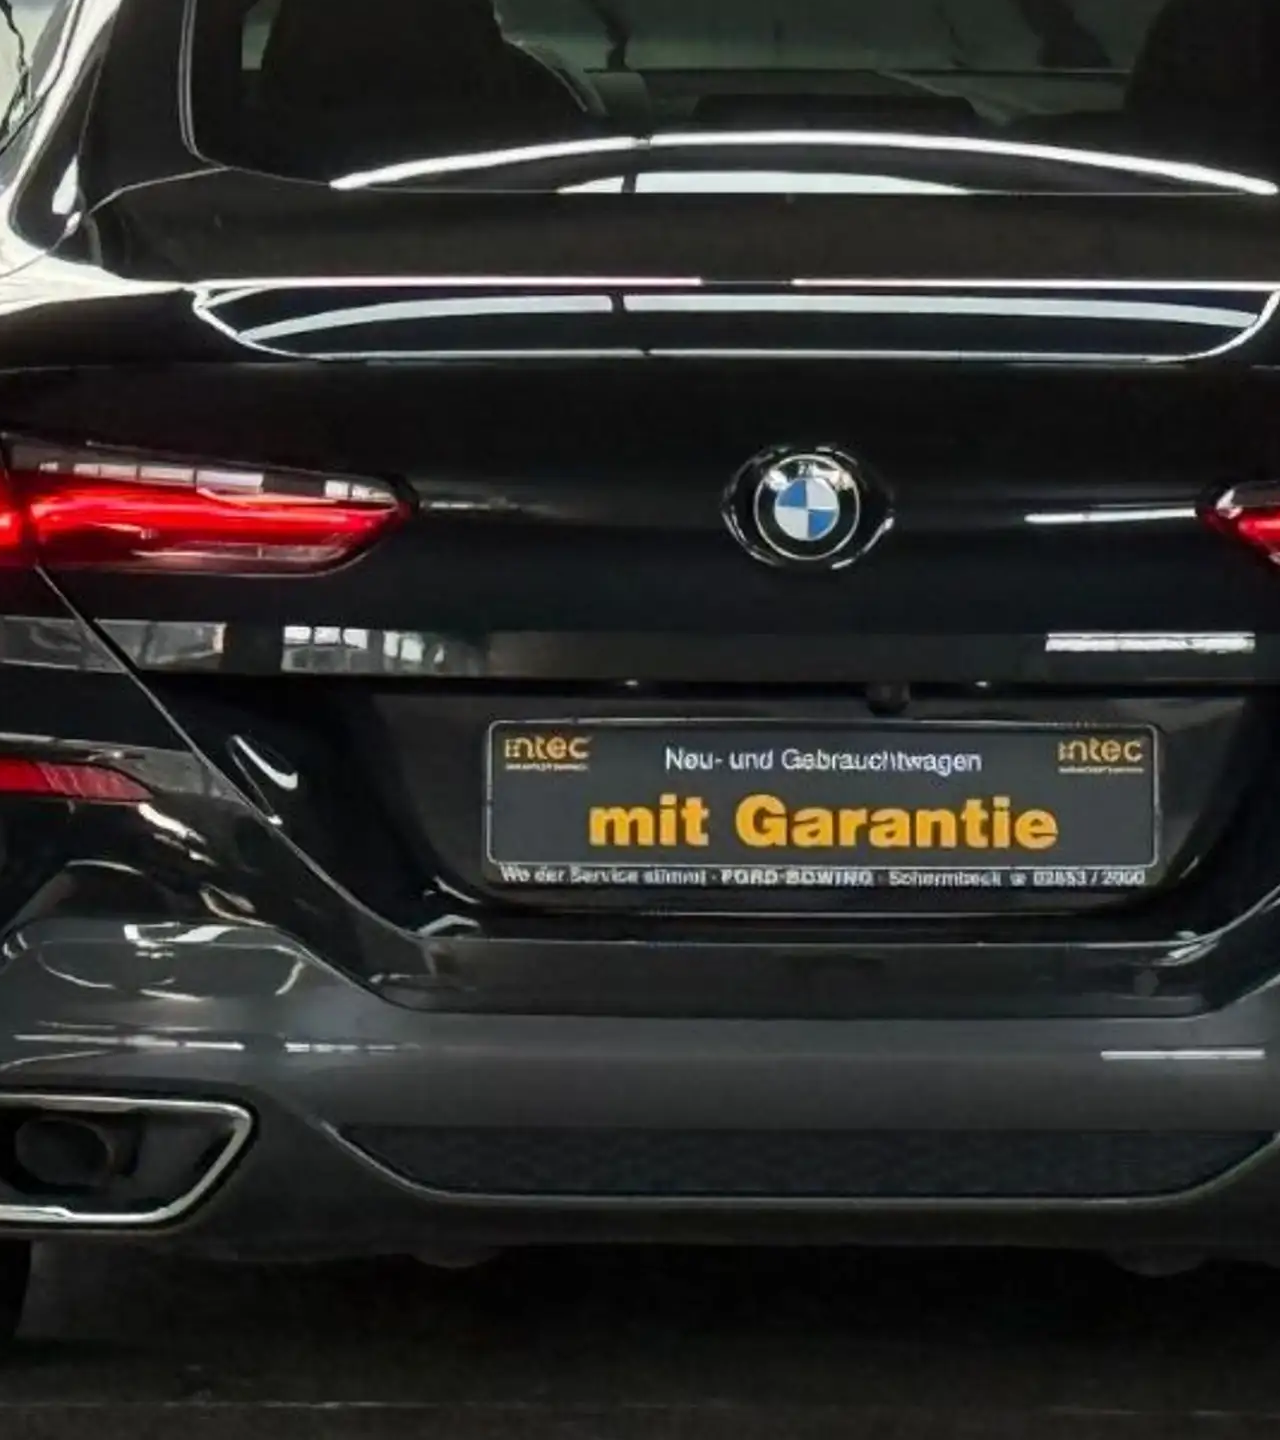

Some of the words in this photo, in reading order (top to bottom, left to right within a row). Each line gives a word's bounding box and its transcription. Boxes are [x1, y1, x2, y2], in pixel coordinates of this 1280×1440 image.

[665, 747, 721, 770] Neu-
[729, 748, 773, 769] und
[781, 748, 982, 776] Gebrauchtwagen
[589, 794, 709, 846] mit
[735, 794, 1058, 849] Garantie
